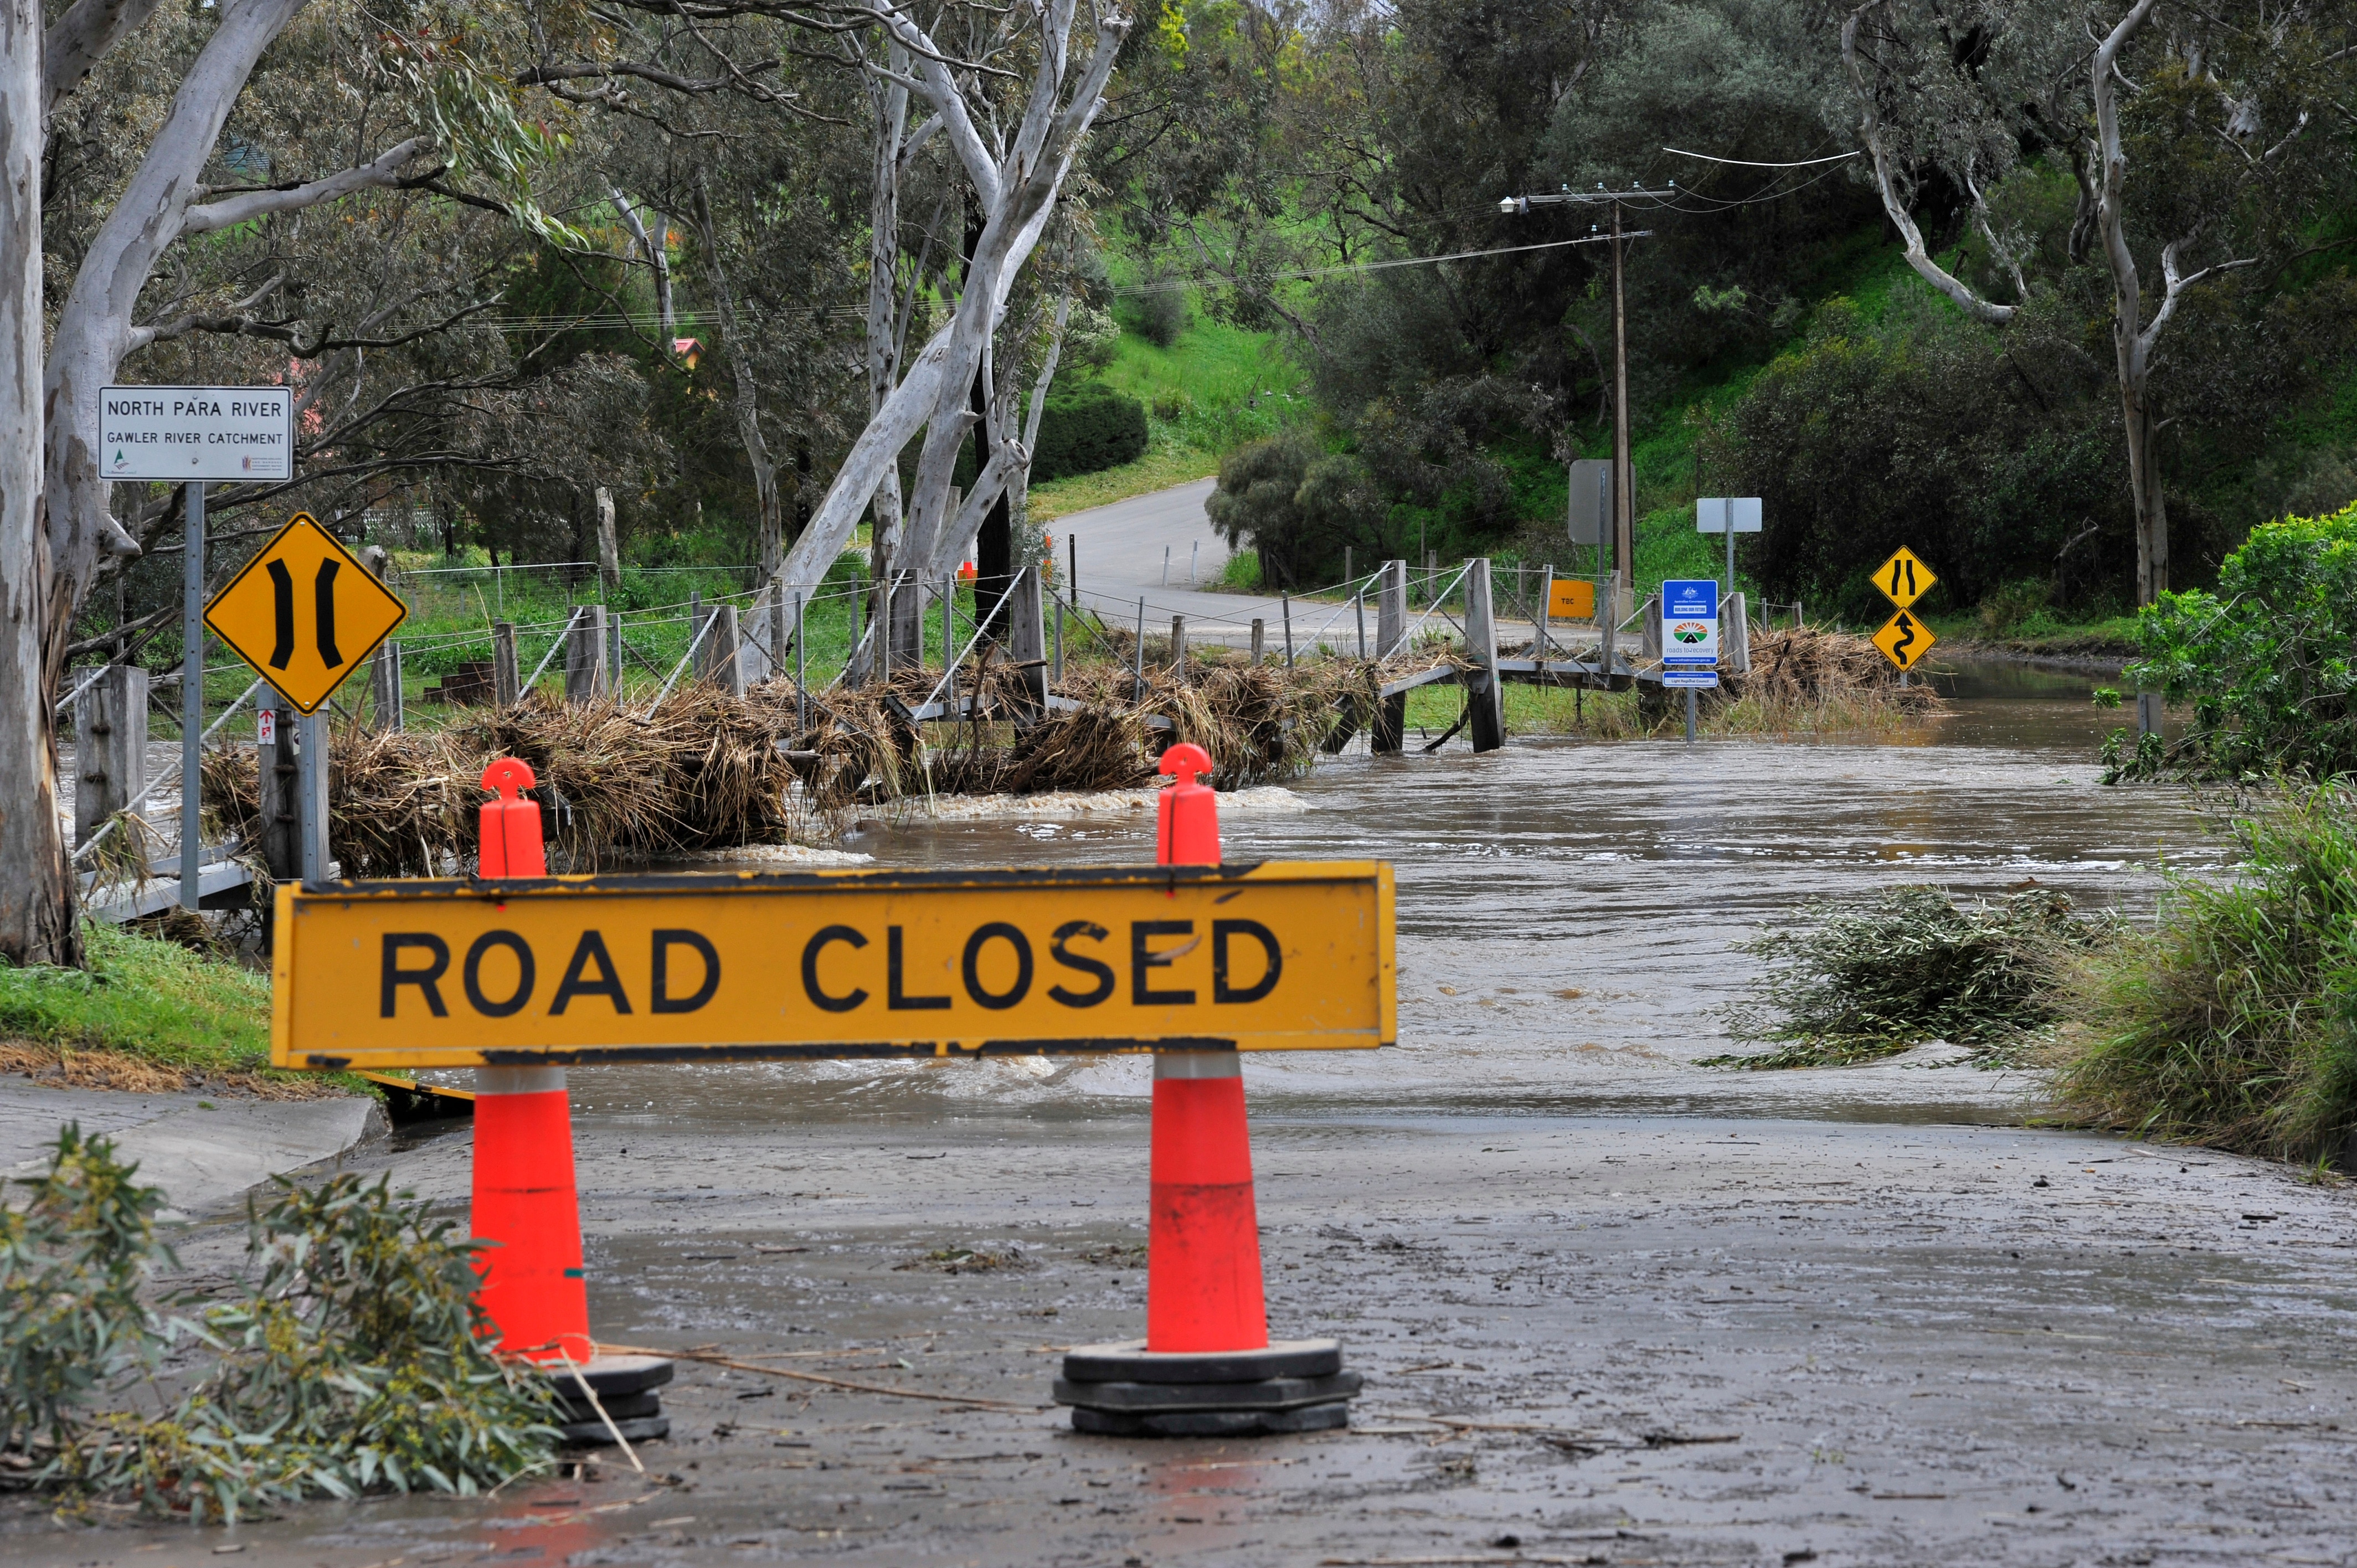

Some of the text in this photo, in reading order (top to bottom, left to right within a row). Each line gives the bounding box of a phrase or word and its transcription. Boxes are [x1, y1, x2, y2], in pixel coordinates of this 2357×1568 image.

[108, 400, 281, 417] NORTH PARA RIVER
[107, 432, 282, 444] GAWLER RIVER CATCHMENT
[380, 918, 1283, 1019] ROAD CLOSED
